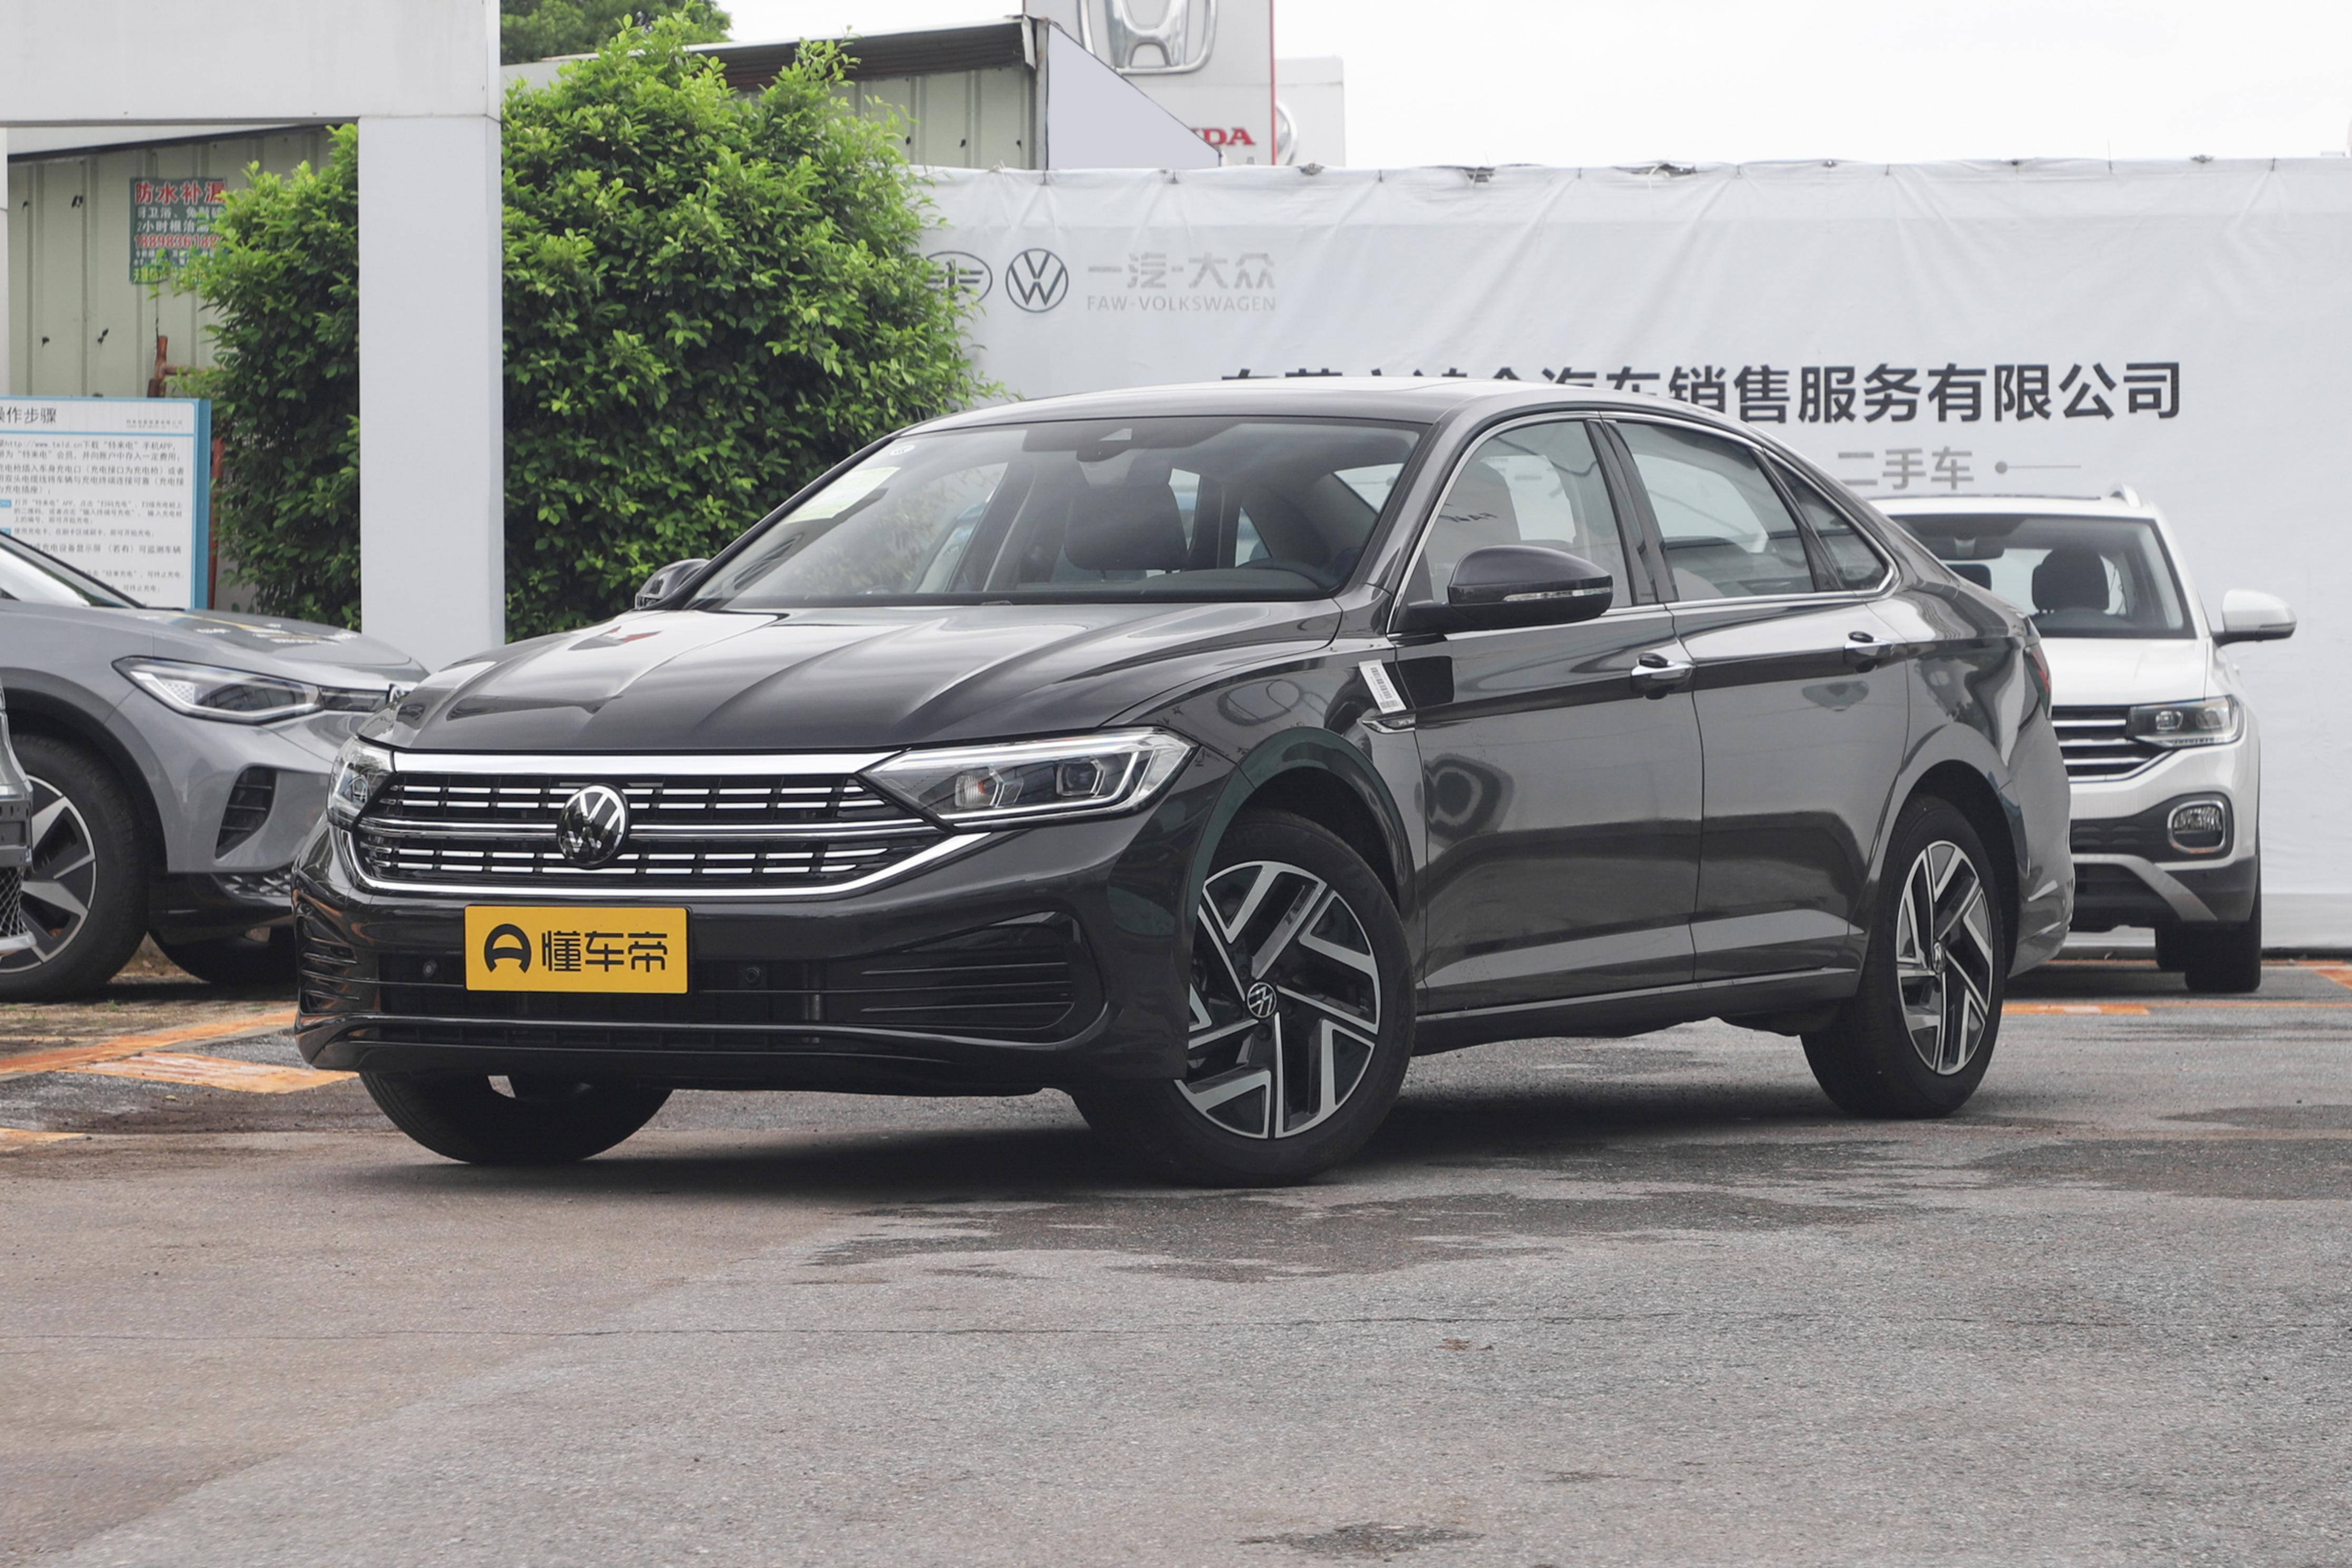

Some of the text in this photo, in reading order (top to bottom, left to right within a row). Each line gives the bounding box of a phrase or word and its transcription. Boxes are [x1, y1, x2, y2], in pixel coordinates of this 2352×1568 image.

[1191, 128, 1255, 146] DA
[1088, 296, 1276, 311] FAW-VOLKSWAGEN
[0, 406, 57, 424] 作步骤
[1837, 446, 1975, 490] 二手车
[542, 930, 667, 973] 懂车帝
